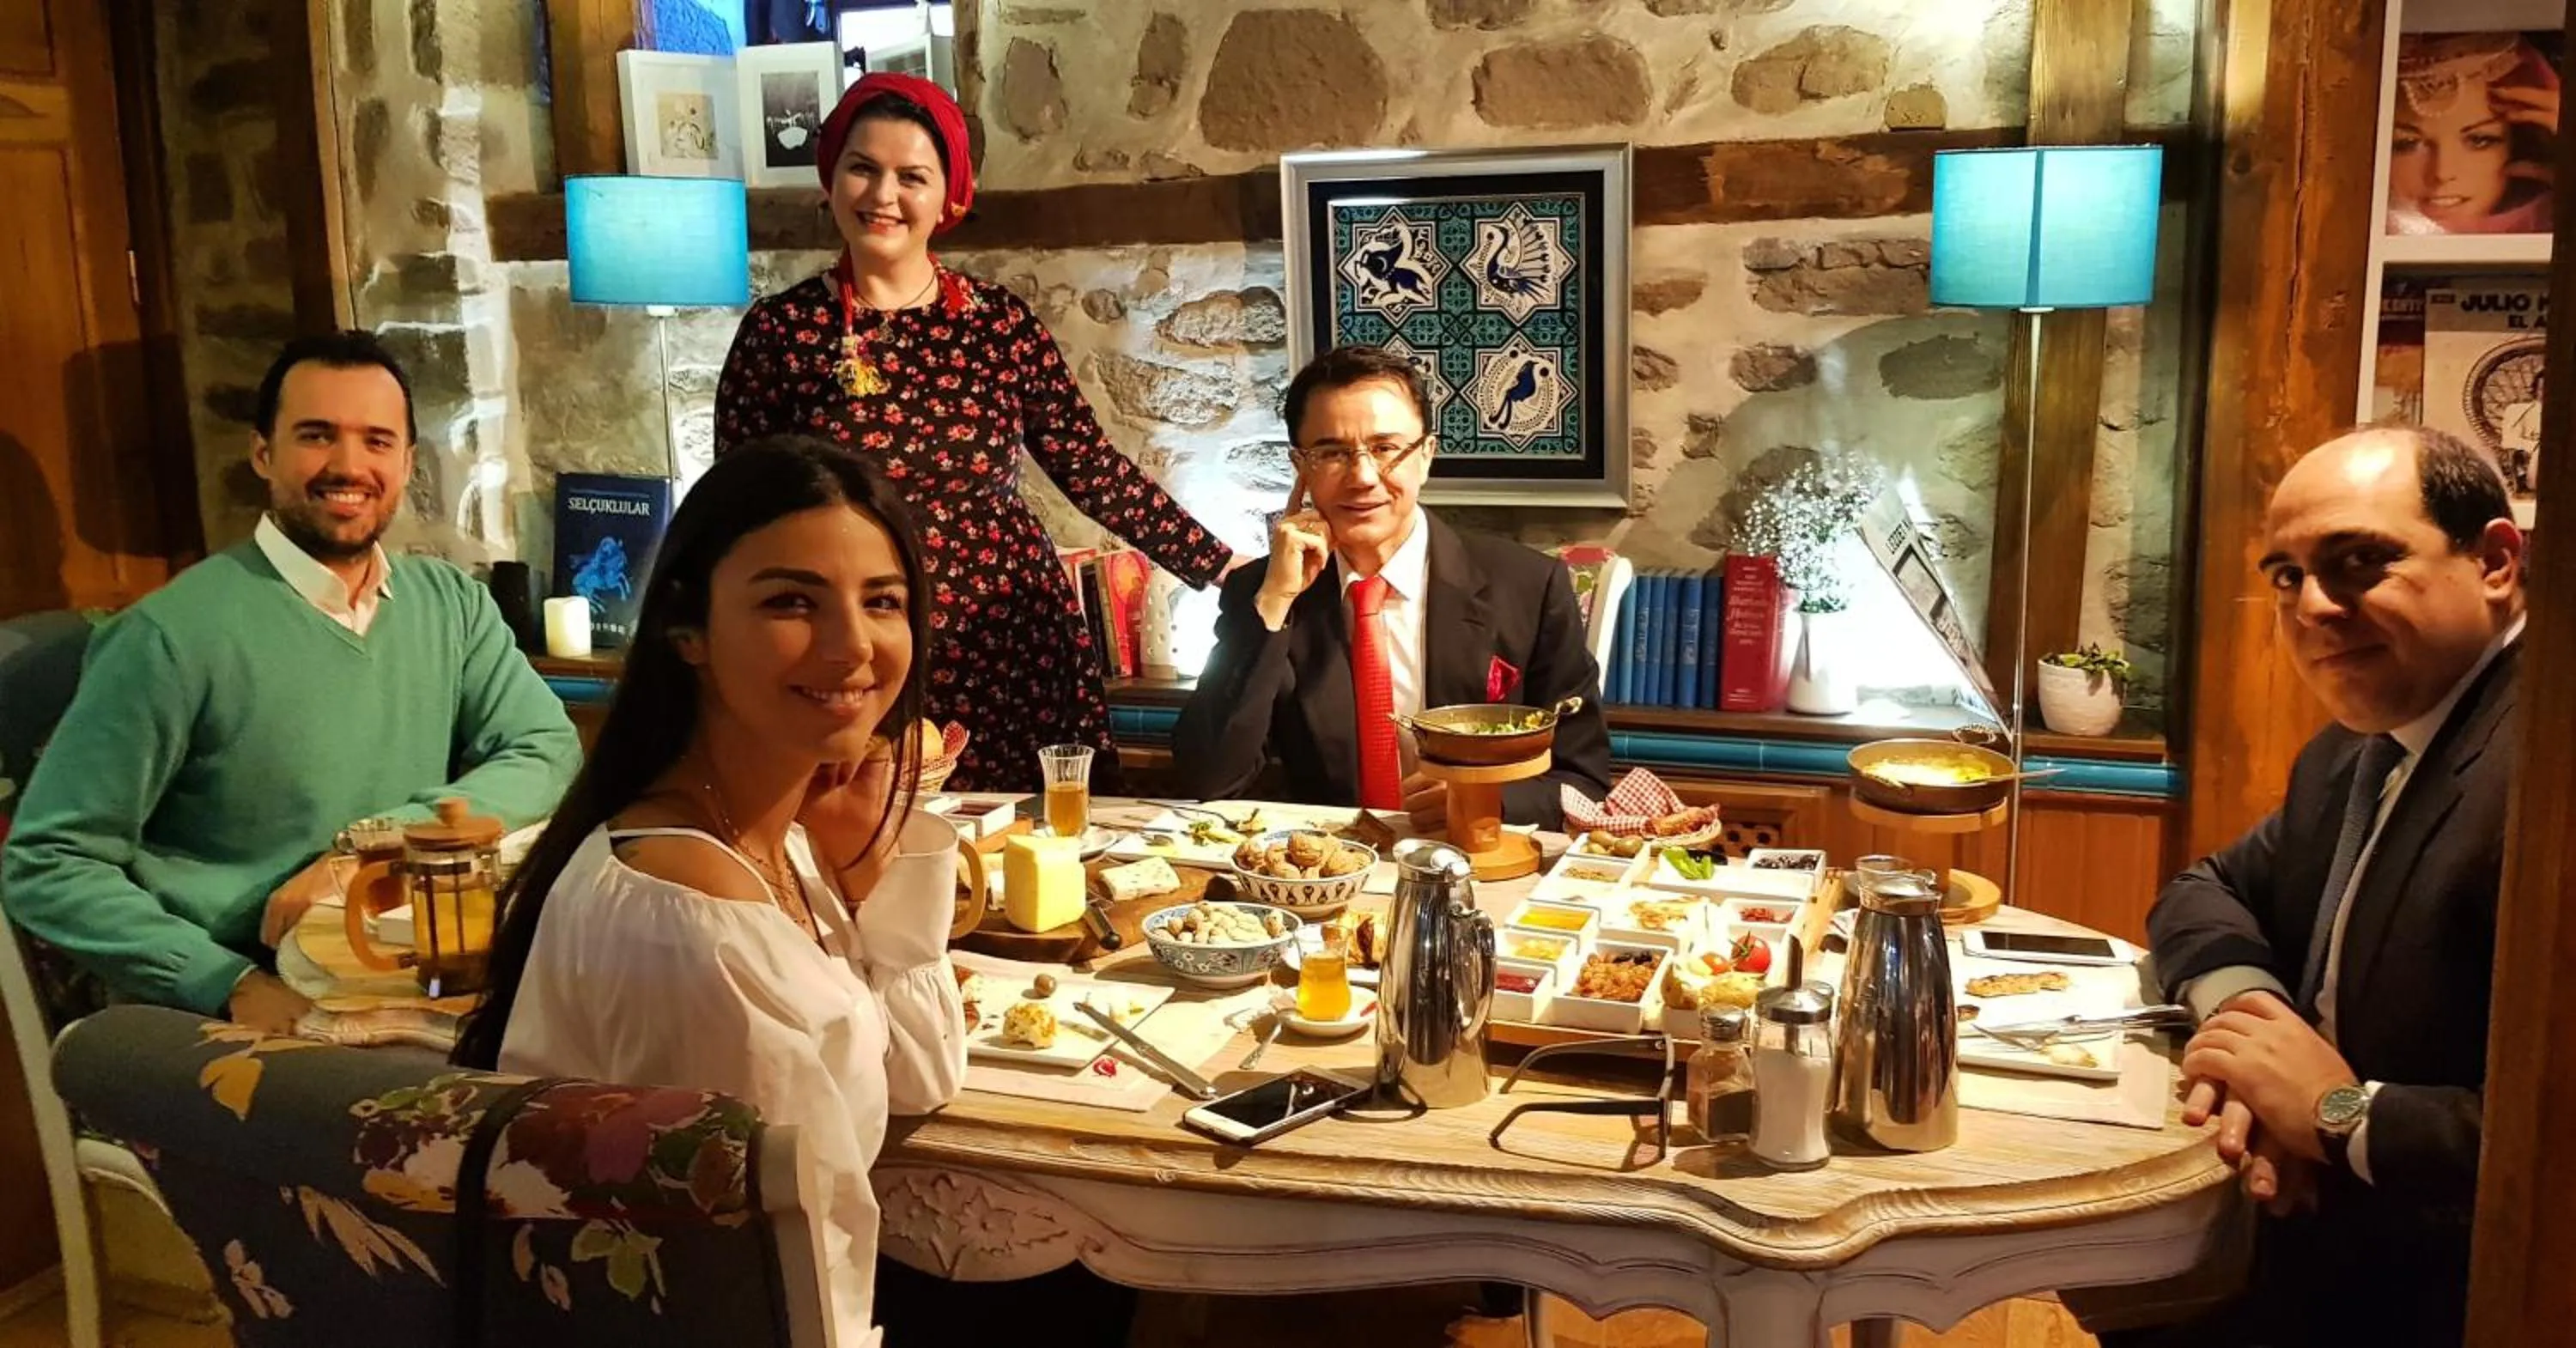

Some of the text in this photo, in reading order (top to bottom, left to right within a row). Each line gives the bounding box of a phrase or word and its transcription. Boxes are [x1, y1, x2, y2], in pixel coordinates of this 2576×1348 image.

[2460, 293, 2530, 312] JULIO
[2507, 314, 2528, 328] EL
[568, 497, 650, 516] SELÇUKLULAR
